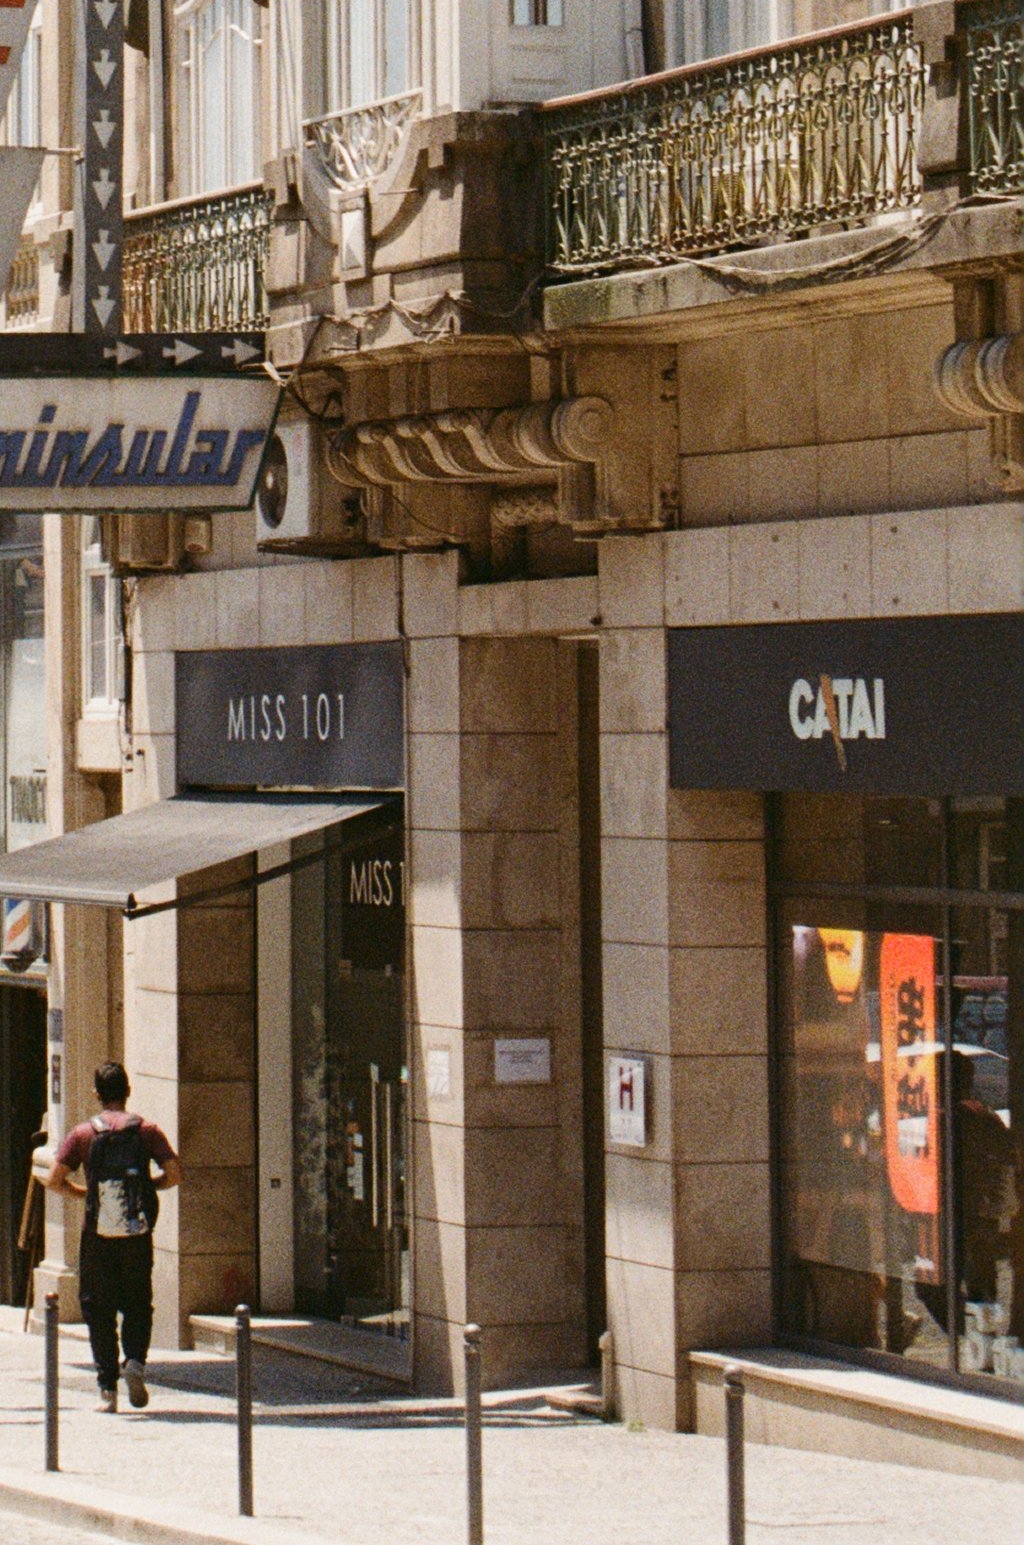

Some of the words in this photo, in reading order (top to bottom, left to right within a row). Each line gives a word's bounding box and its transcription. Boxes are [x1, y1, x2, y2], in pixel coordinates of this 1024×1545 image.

[228, 694, 286, 741] MISS
[302, 693, 345, 740] 101
[789, 678, 886, 740] CATAI
[350, 860, 393, 906] MISS
[619, 1066, 634, 1111] H
